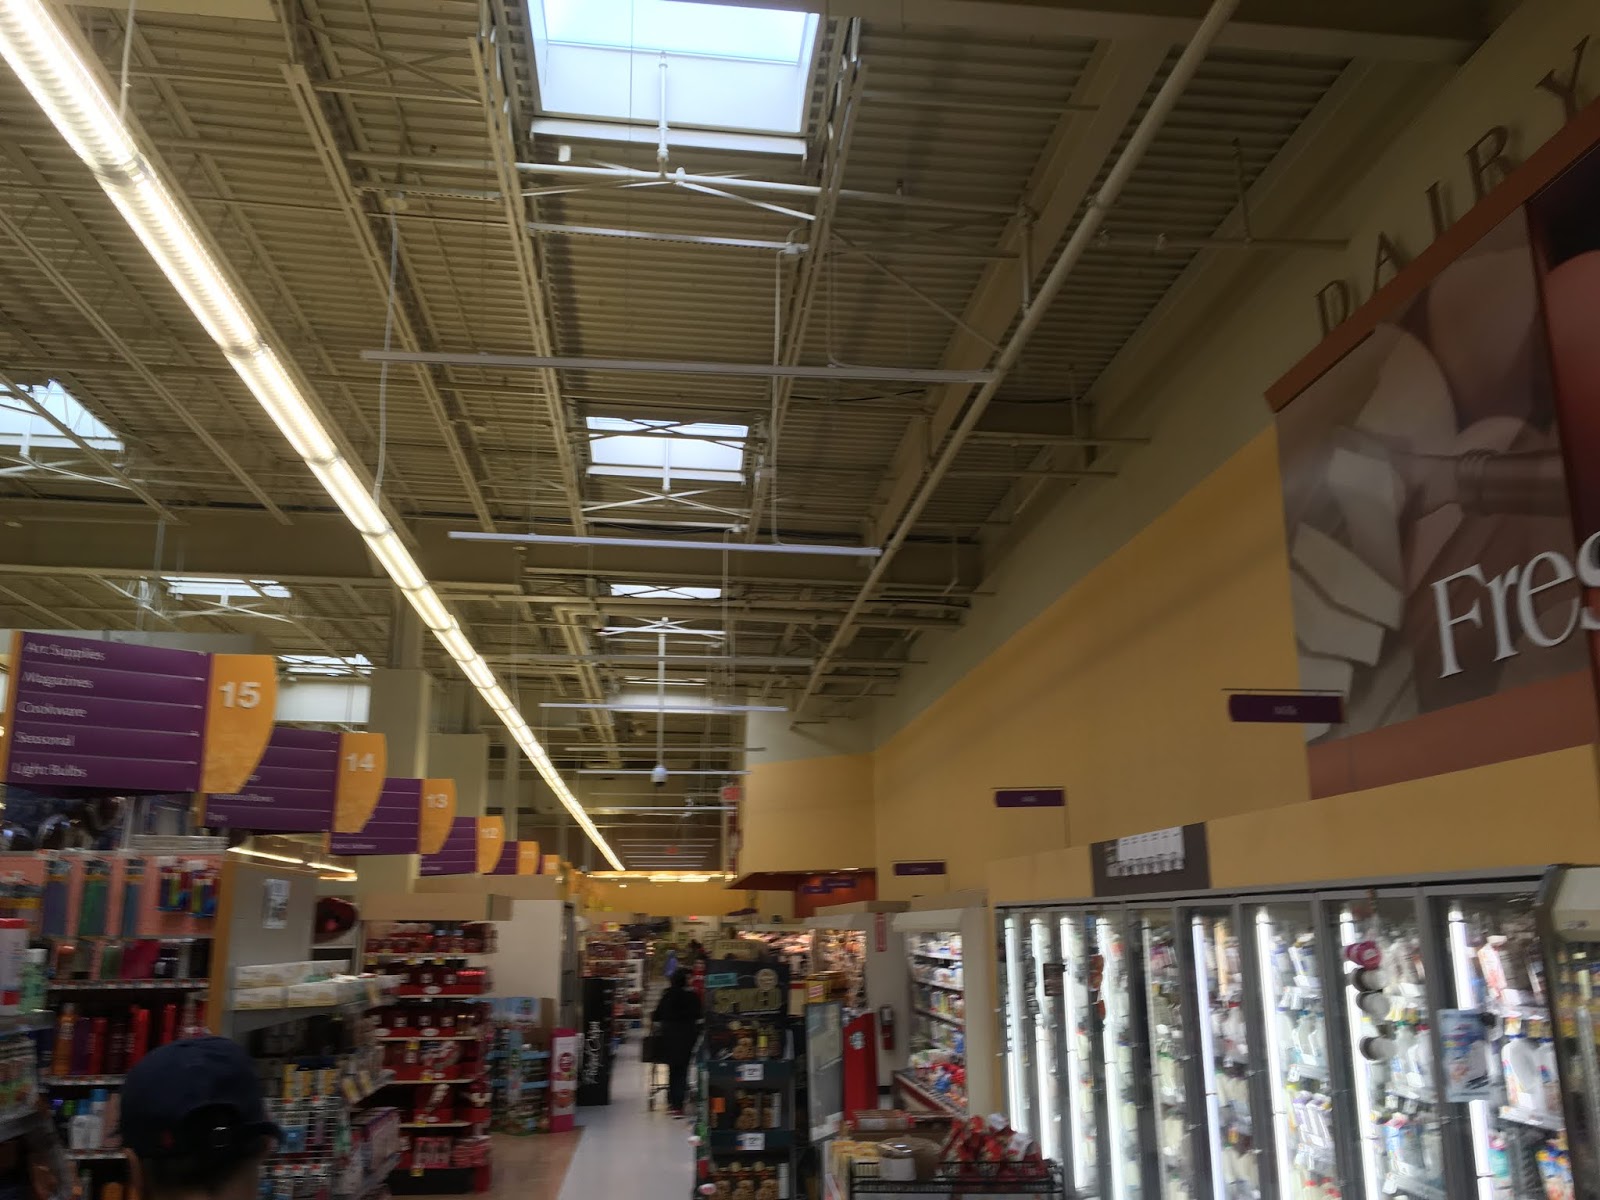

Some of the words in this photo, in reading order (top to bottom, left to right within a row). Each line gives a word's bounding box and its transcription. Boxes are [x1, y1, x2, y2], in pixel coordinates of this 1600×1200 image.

[1313, 34, 1590, 337] DAIRY
[48, 644, 105, 661] Supplies
[22, 671, 94, 688] Magazines
[219, 681, 262, 709] 15
[17, 701, 88, 718] Cookware
[14, 731, 76, 746] Seasonal
[11, 761, 47, 778] Light
[48, 764, 88, 778] Bulbs
[345, 753, 376, 772] 14
[425, 793, 448, 809] 13
